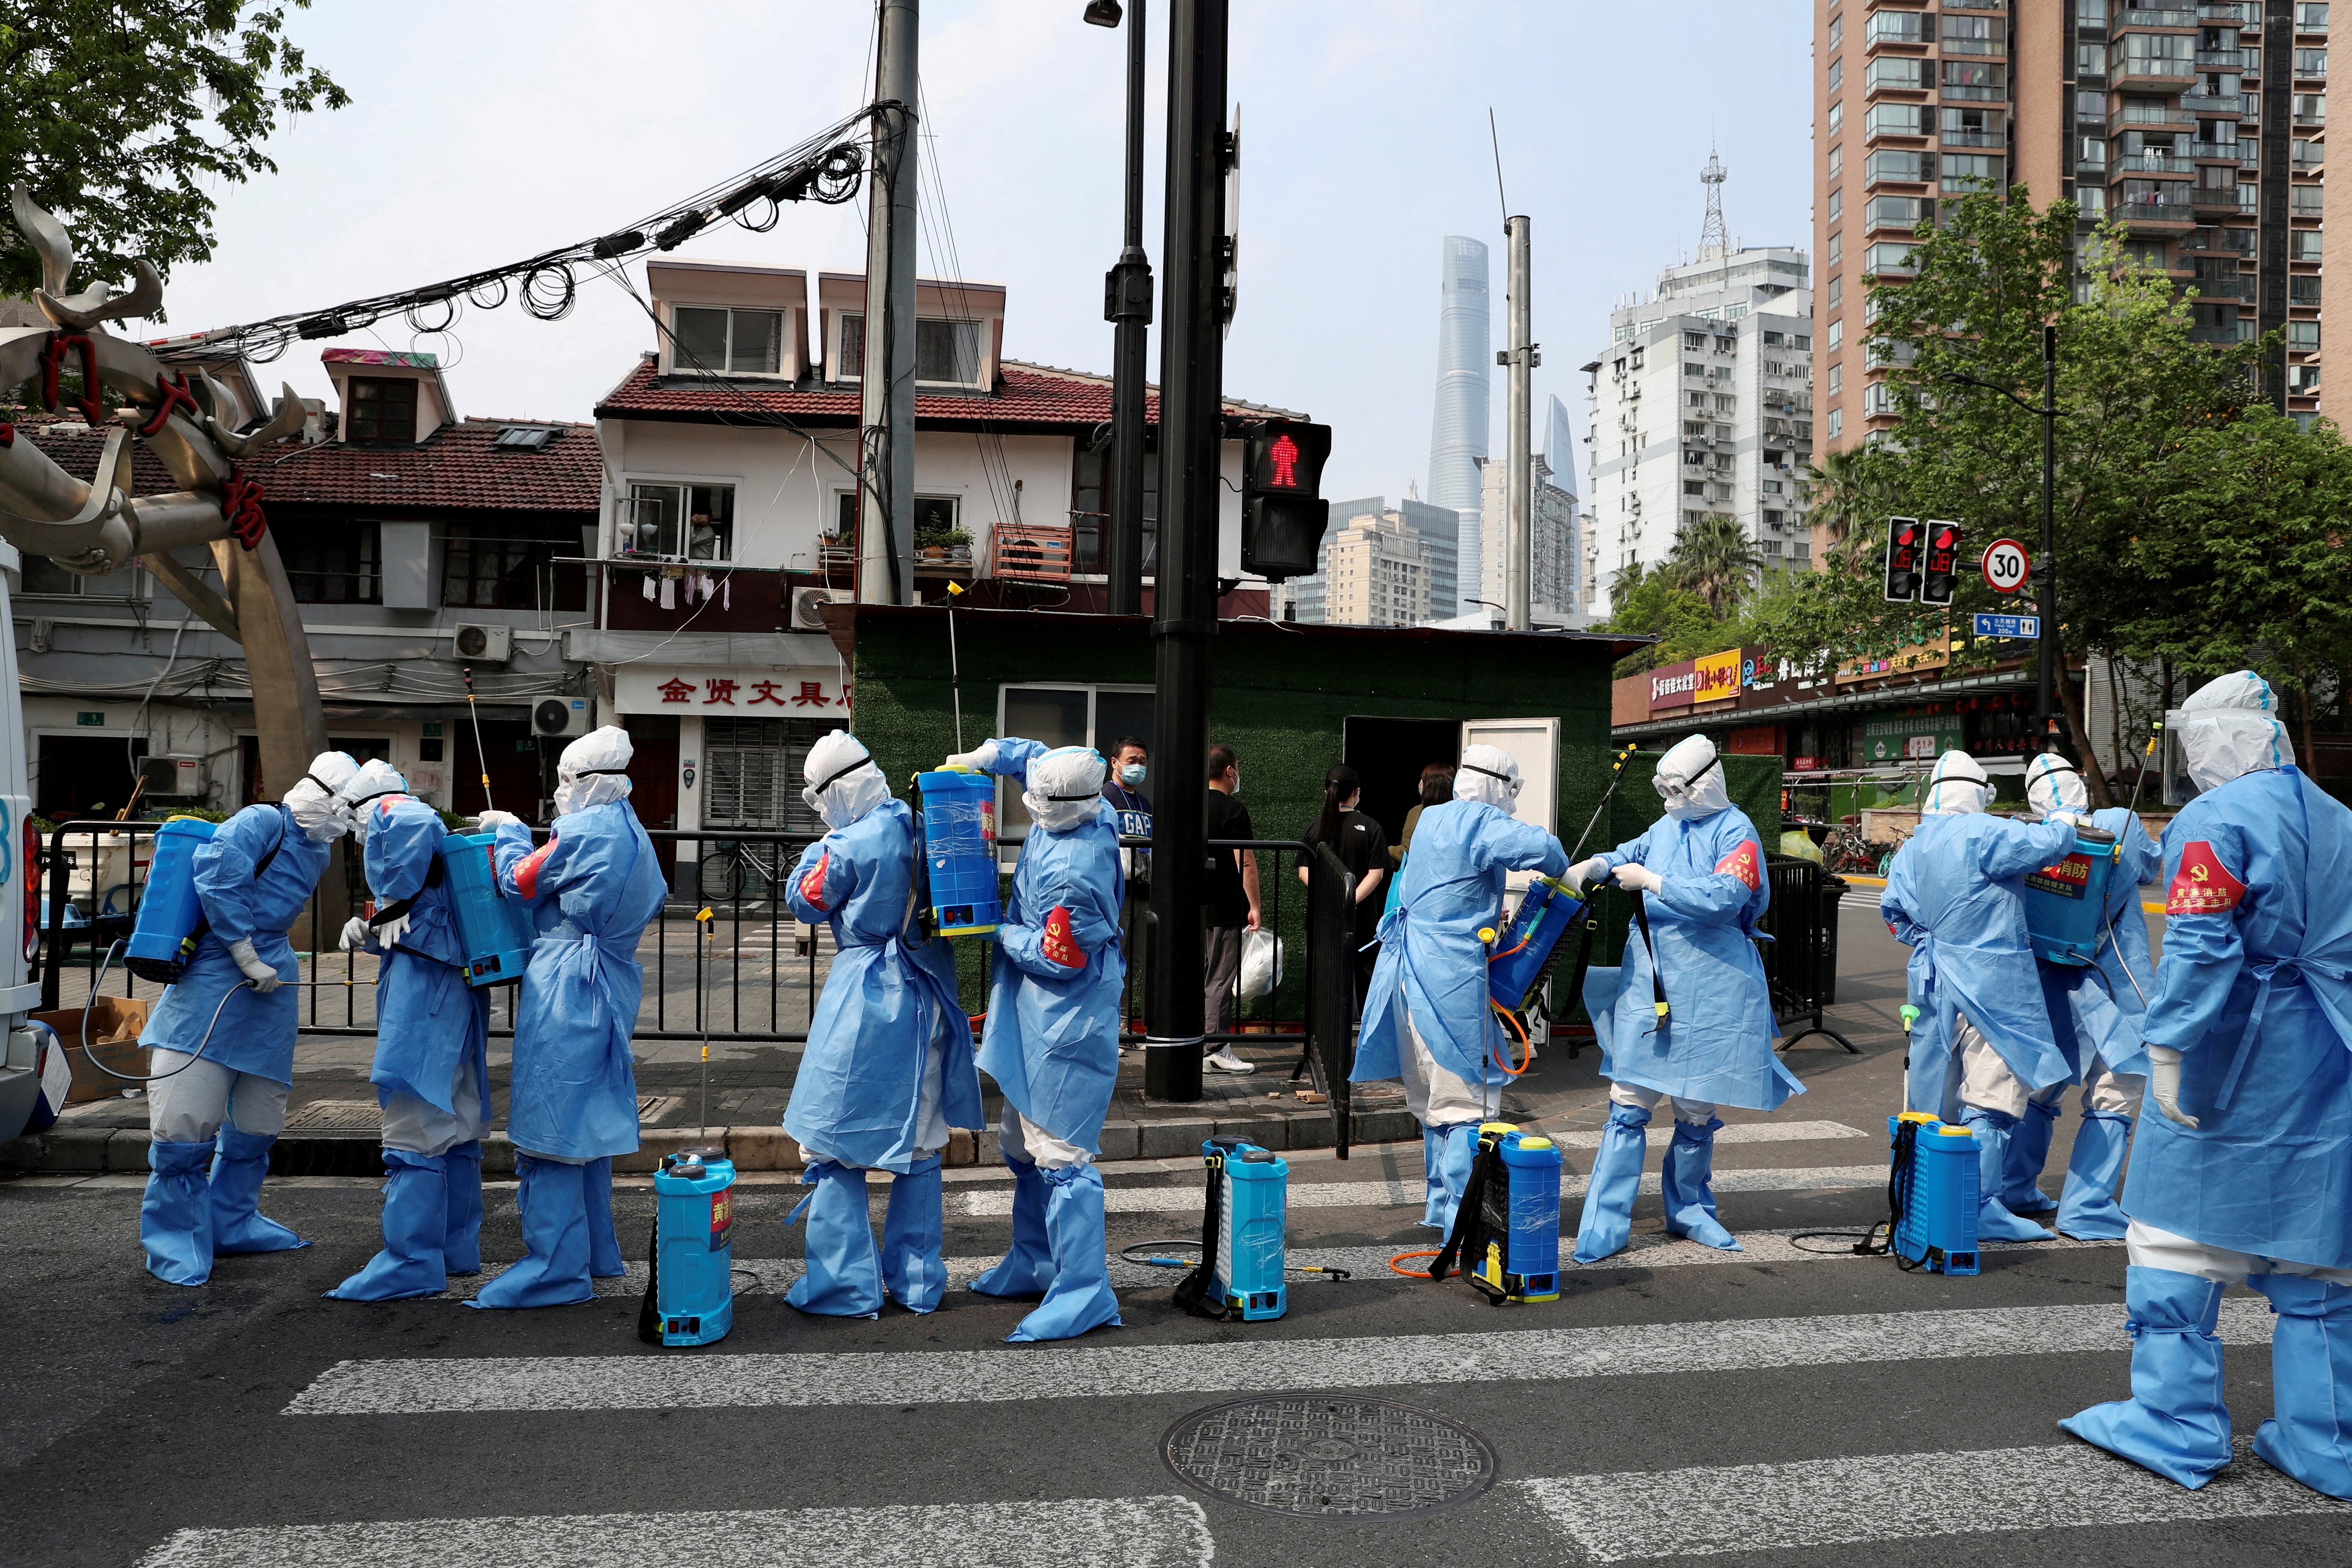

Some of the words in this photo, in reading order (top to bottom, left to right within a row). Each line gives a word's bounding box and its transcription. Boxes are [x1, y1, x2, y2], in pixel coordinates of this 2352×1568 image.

[1994, 554, 2019, 578] 30
[1124, 813, 1151, 835] GAP
[2058, 861, 2089, 879] 消防
[2051, 888, 2073, 897] RESCURE
[2177, 888, 2227, 897] 黄浦消防
[2171, 898, 2232, 908] 党员突击队
